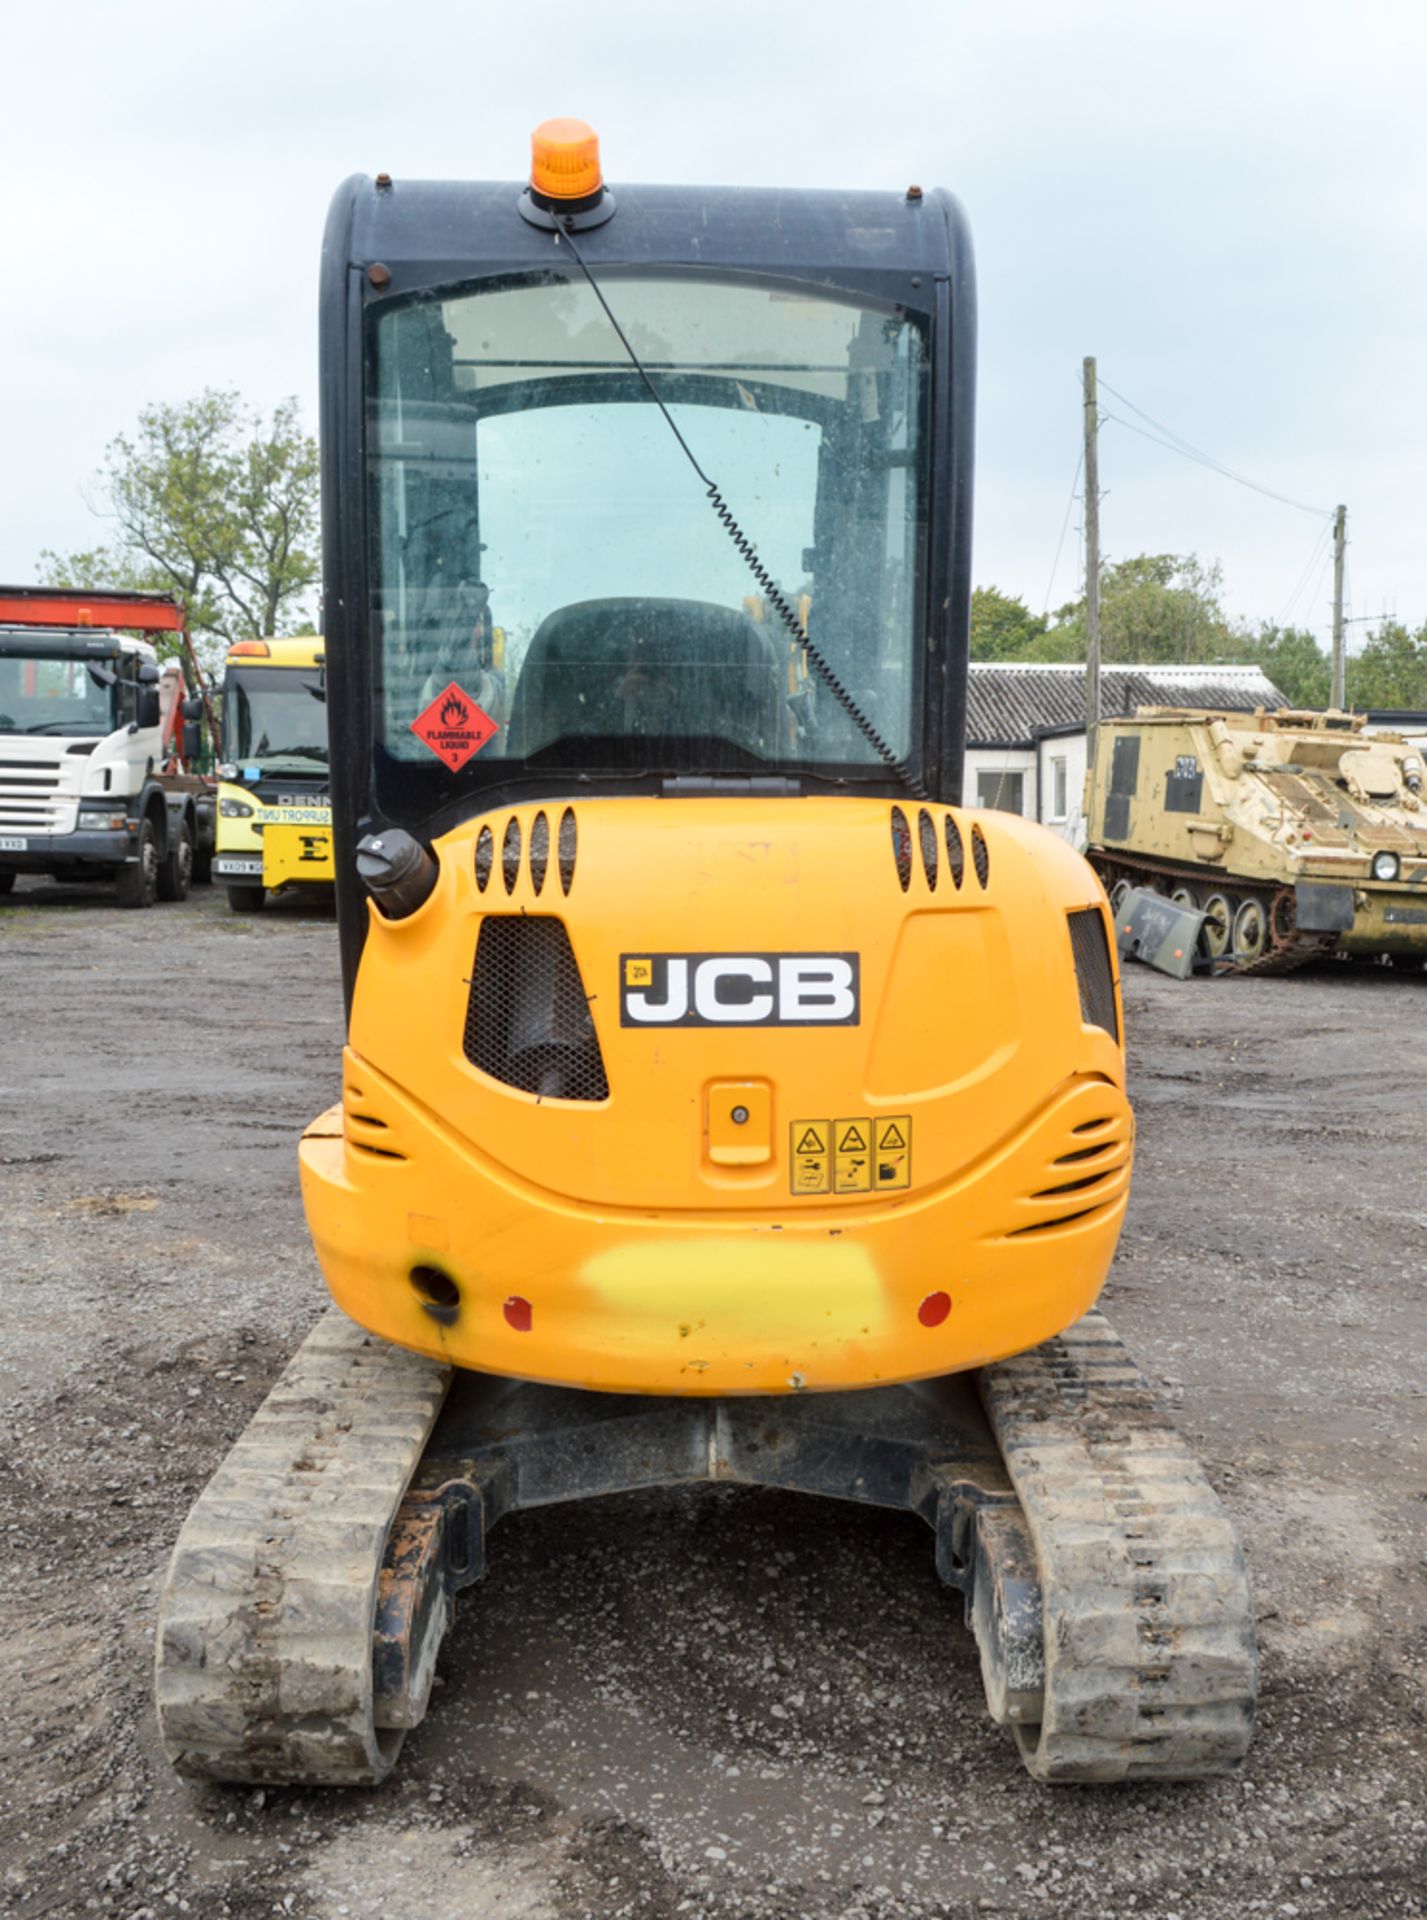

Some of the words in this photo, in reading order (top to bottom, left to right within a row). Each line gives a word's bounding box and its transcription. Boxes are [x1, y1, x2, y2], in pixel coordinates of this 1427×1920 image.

[427, 730, 482, 740] FLAMMABLE
[440, 741, 469, 750] LIQUID
[451, 752, 458, 763] 3
[626, 958, 855, 1022] JCB
